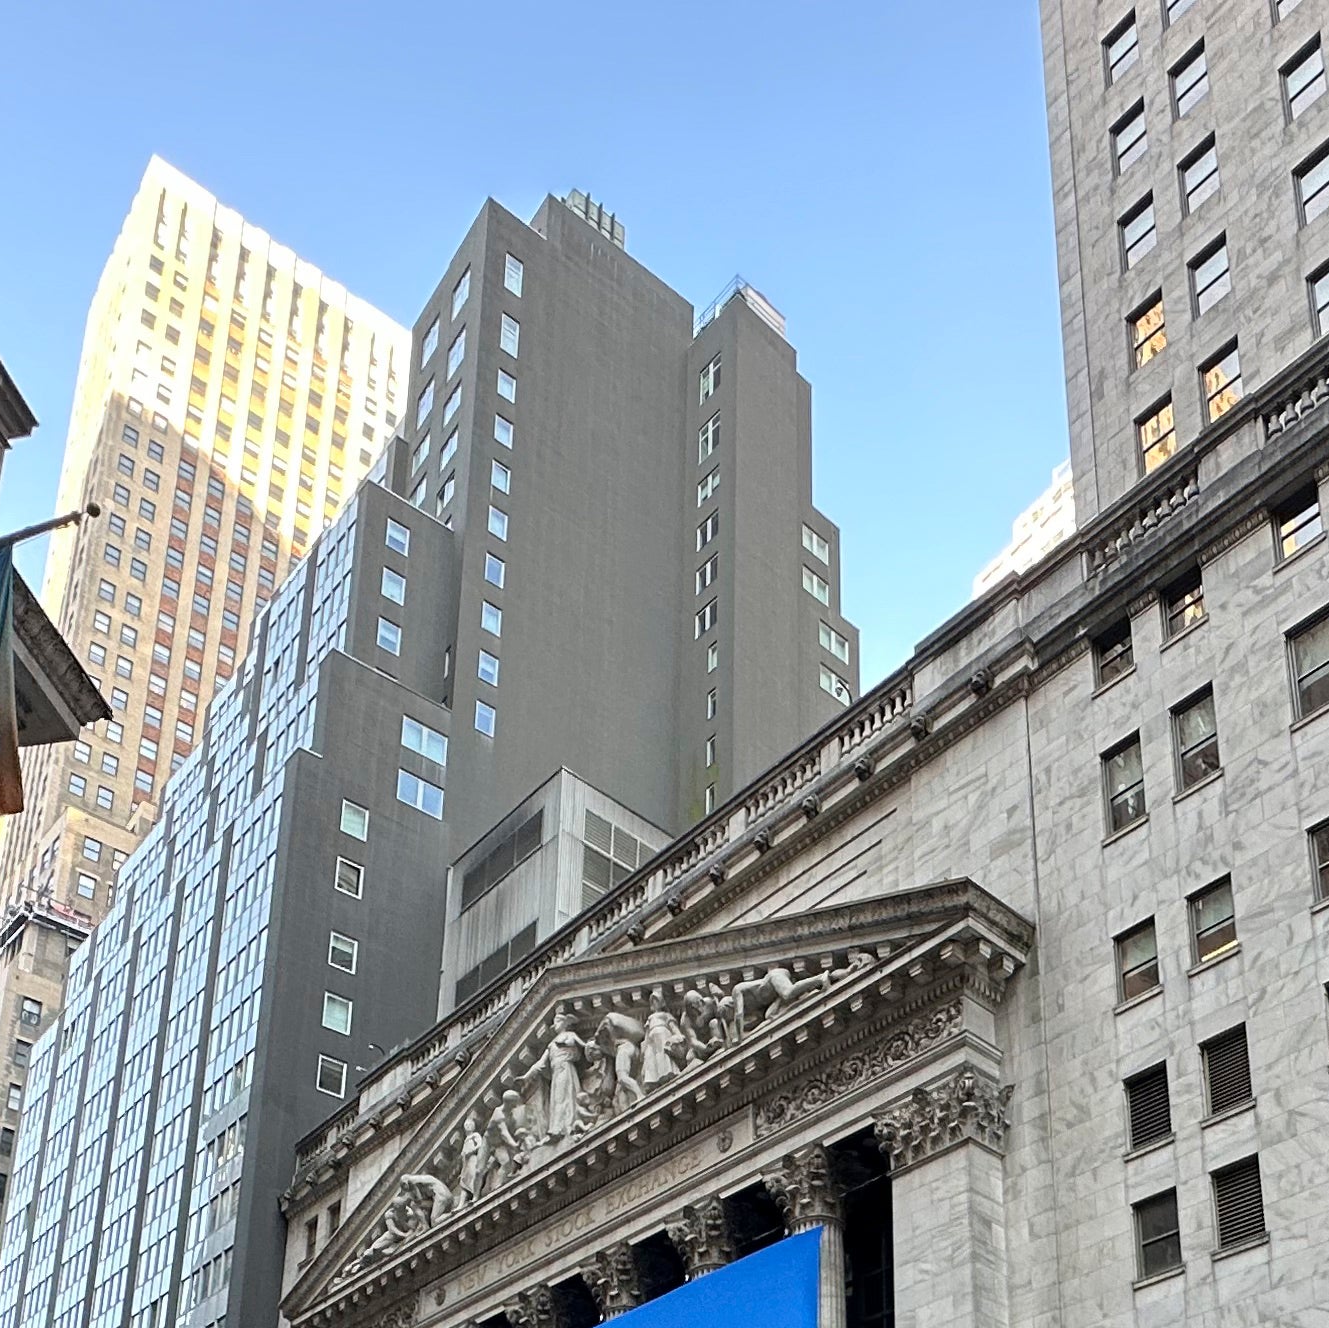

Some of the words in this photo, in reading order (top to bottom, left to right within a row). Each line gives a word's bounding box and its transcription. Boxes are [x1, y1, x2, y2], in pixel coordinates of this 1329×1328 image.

[455, 1264, 488, 1295] NEW
[495, 1240, 535, 1273] YORK
[544, 1206, 596, 1247] STOCK
[605, 1147, 704, 1216] EXCHANGE
